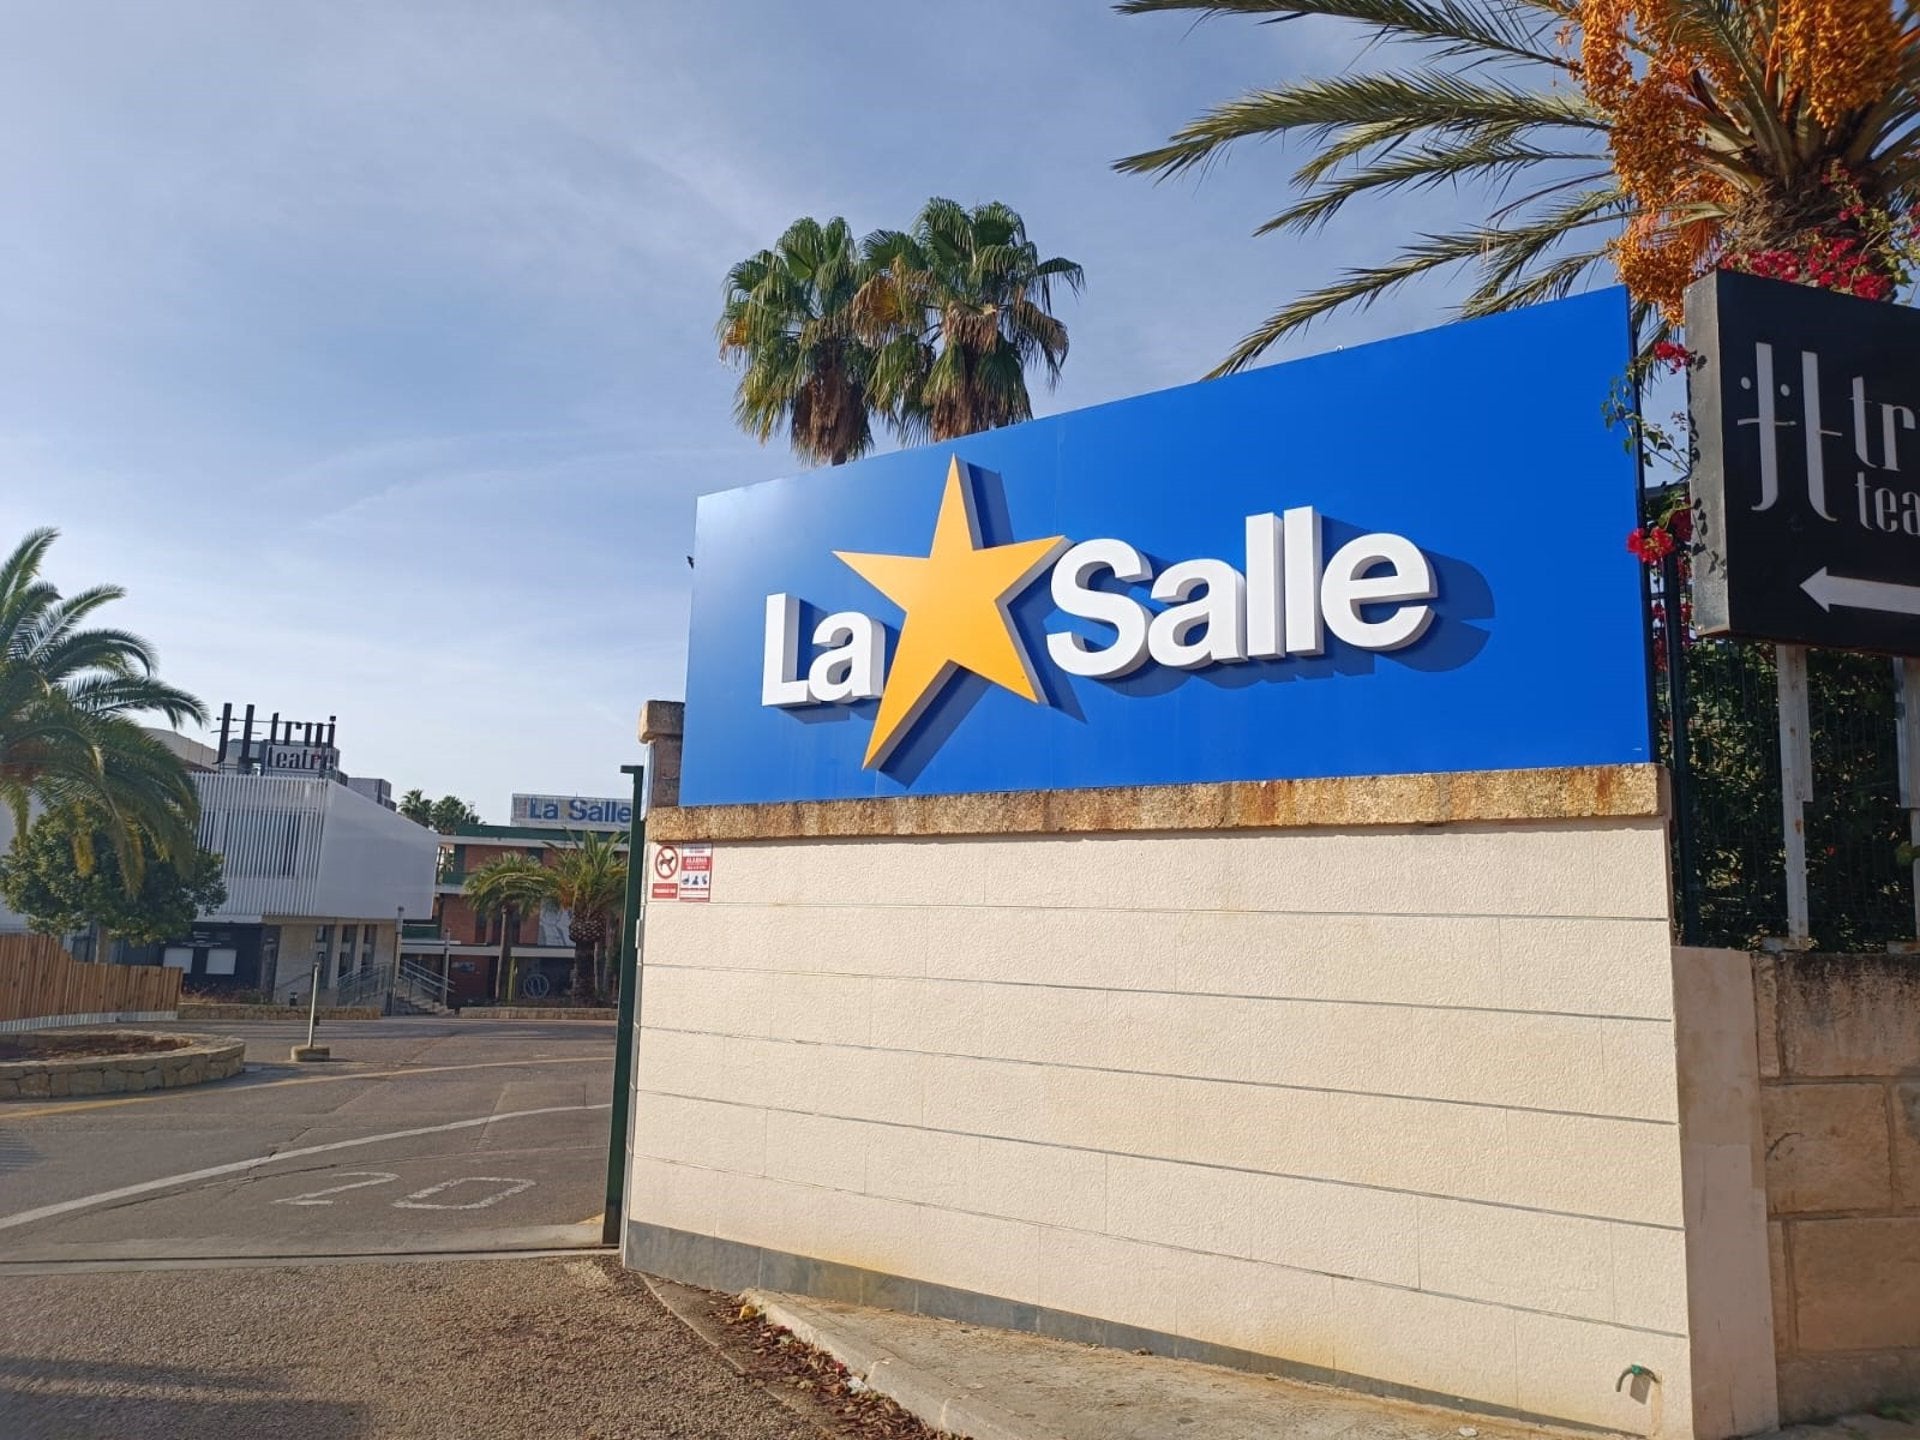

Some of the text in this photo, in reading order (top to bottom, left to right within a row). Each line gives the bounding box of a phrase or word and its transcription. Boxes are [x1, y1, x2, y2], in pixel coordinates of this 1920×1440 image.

[1849, 376, 1920, 472] tr
[762, 506, 1438, 707] La Salle
[529, 797, 632, 823] La Salle
